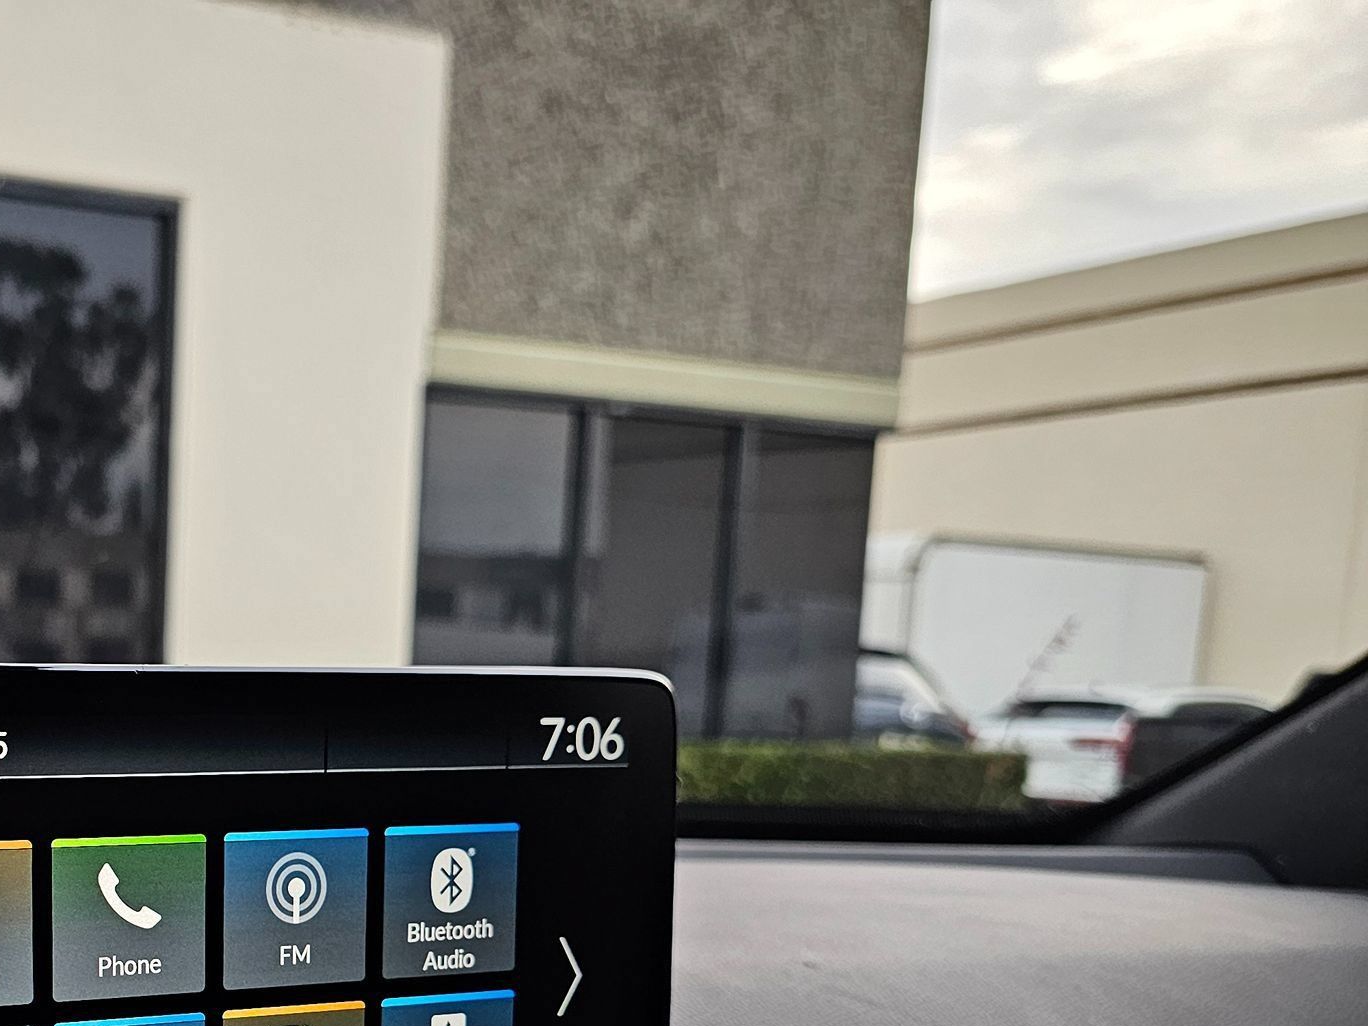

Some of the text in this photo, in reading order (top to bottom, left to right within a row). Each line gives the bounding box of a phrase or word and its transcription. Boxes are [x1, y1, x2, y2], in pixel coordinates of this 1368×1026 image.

[539, 716, 625, 761] 7:06
[407, 918, 494, 943] Bluetooth
[98, 955, 162, 978] Phone
[279, 943, 311, 966] FM
[422, 948, 476, 972] Audio
